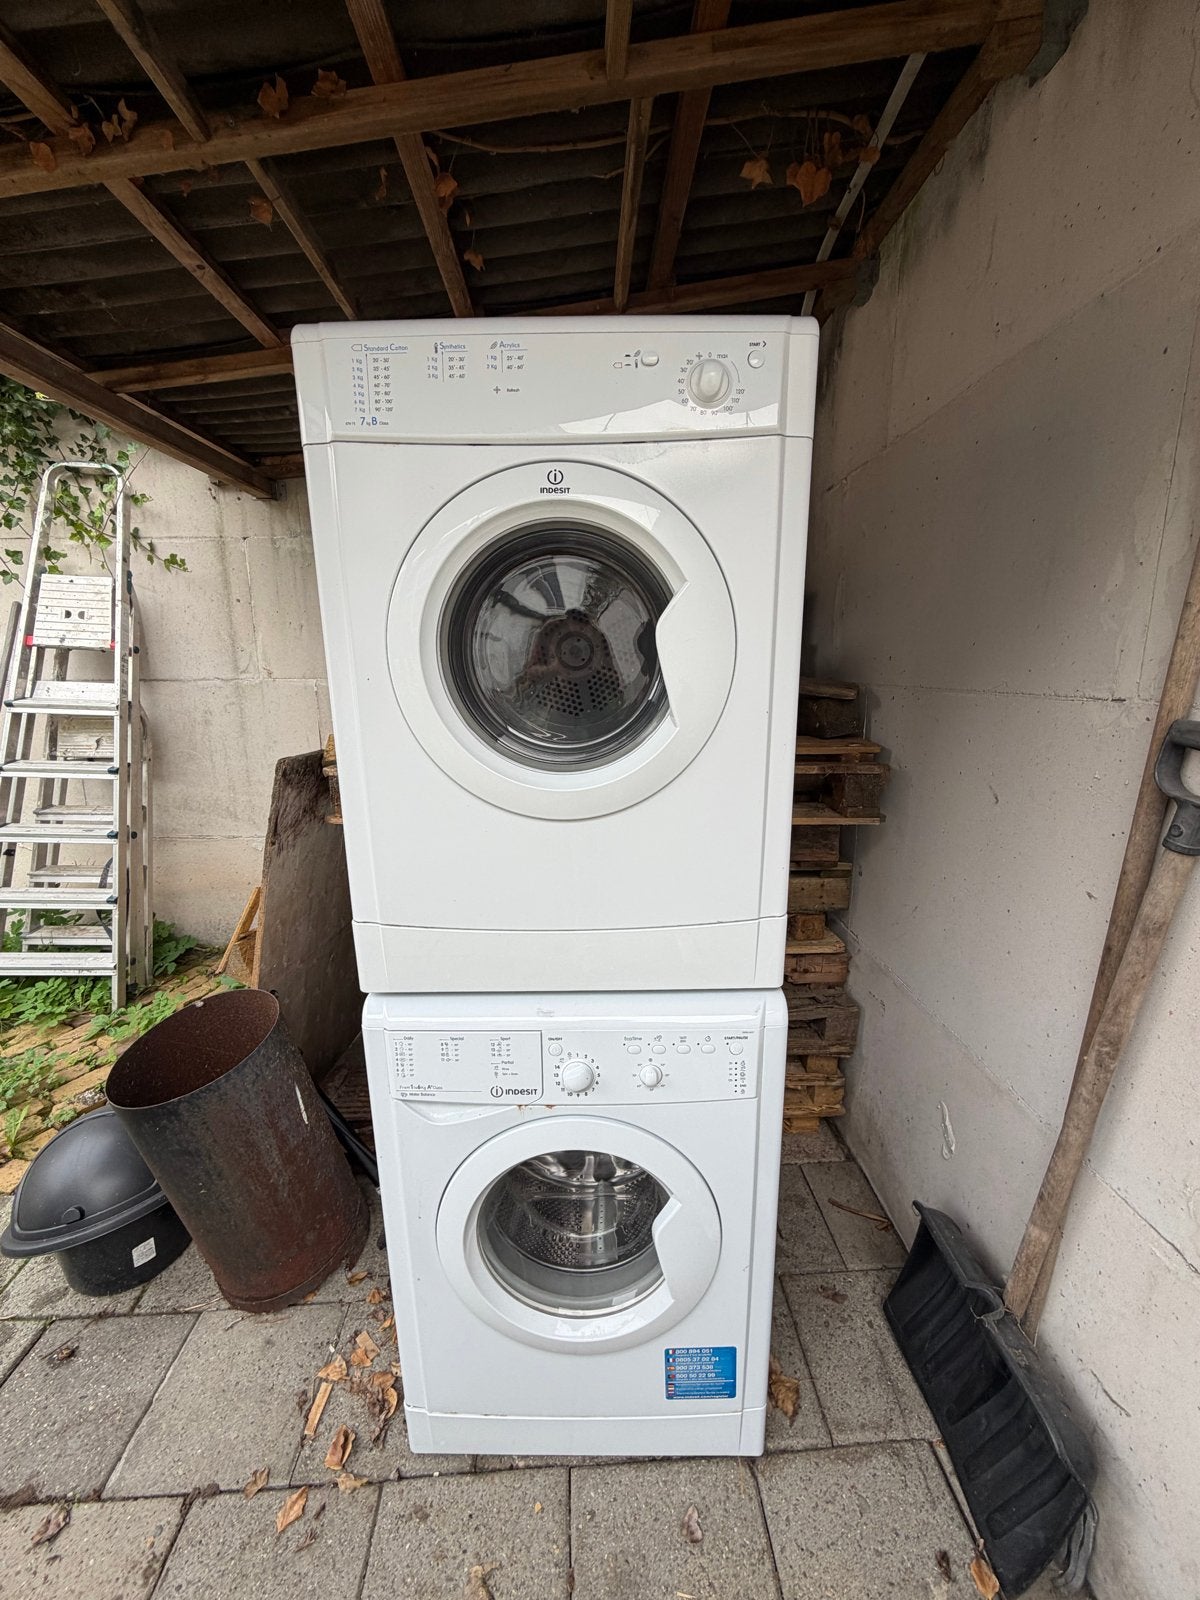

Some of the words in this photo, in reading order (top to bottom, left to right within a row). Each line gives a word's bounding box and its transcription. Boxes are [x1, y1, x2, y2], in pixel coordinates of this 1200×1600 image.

[440, 342, 466, 350] Synthetics
[360, 416, 365, 425] 7
[372, 416, 377, 425] B
